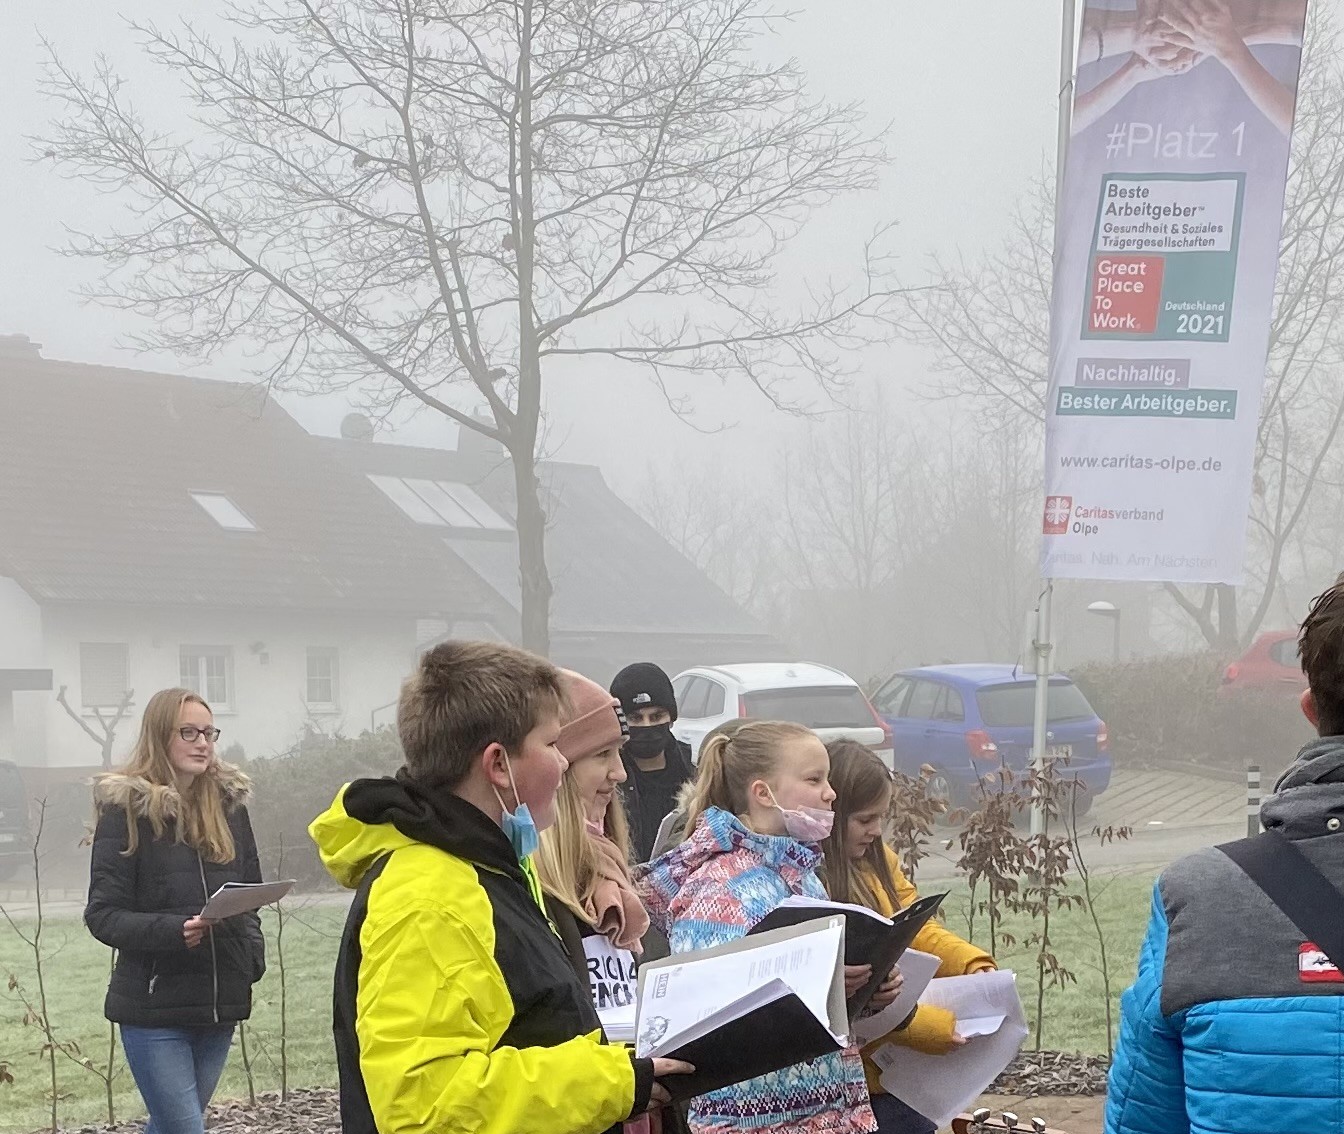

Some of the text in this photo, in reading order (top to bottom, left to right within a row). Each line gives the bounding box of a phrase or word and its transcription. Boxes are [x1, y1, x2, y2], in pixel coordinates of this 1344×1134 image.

[1106, 121, 1247, 159] #Platz 1
[1107, 184, 1150, 199] Beste
[1103, 222, 1224, 235] Gesundheit & Soziales
[1102, 236, 1216, 249] Trägergesellschaften
[1098, 260, 1147, 276] Great
[1097, 277, 1144, 293] Place
[1095, 295, 1112, 310] To
[1165, 301, 1225, 312] Deutschland
[1176, 314, 1225, 335] 2021
[1082, 363, 1181, 386] Nachhaltig.
[1060, 393, 1232, 415] Bester Arbeitgeber.
[1060, 455, 1223, 473] www.caritas-olpe.de
[1074, 506, 1165, 522] Caritasverband
[1072, 522, 1099, 537] Olpe
